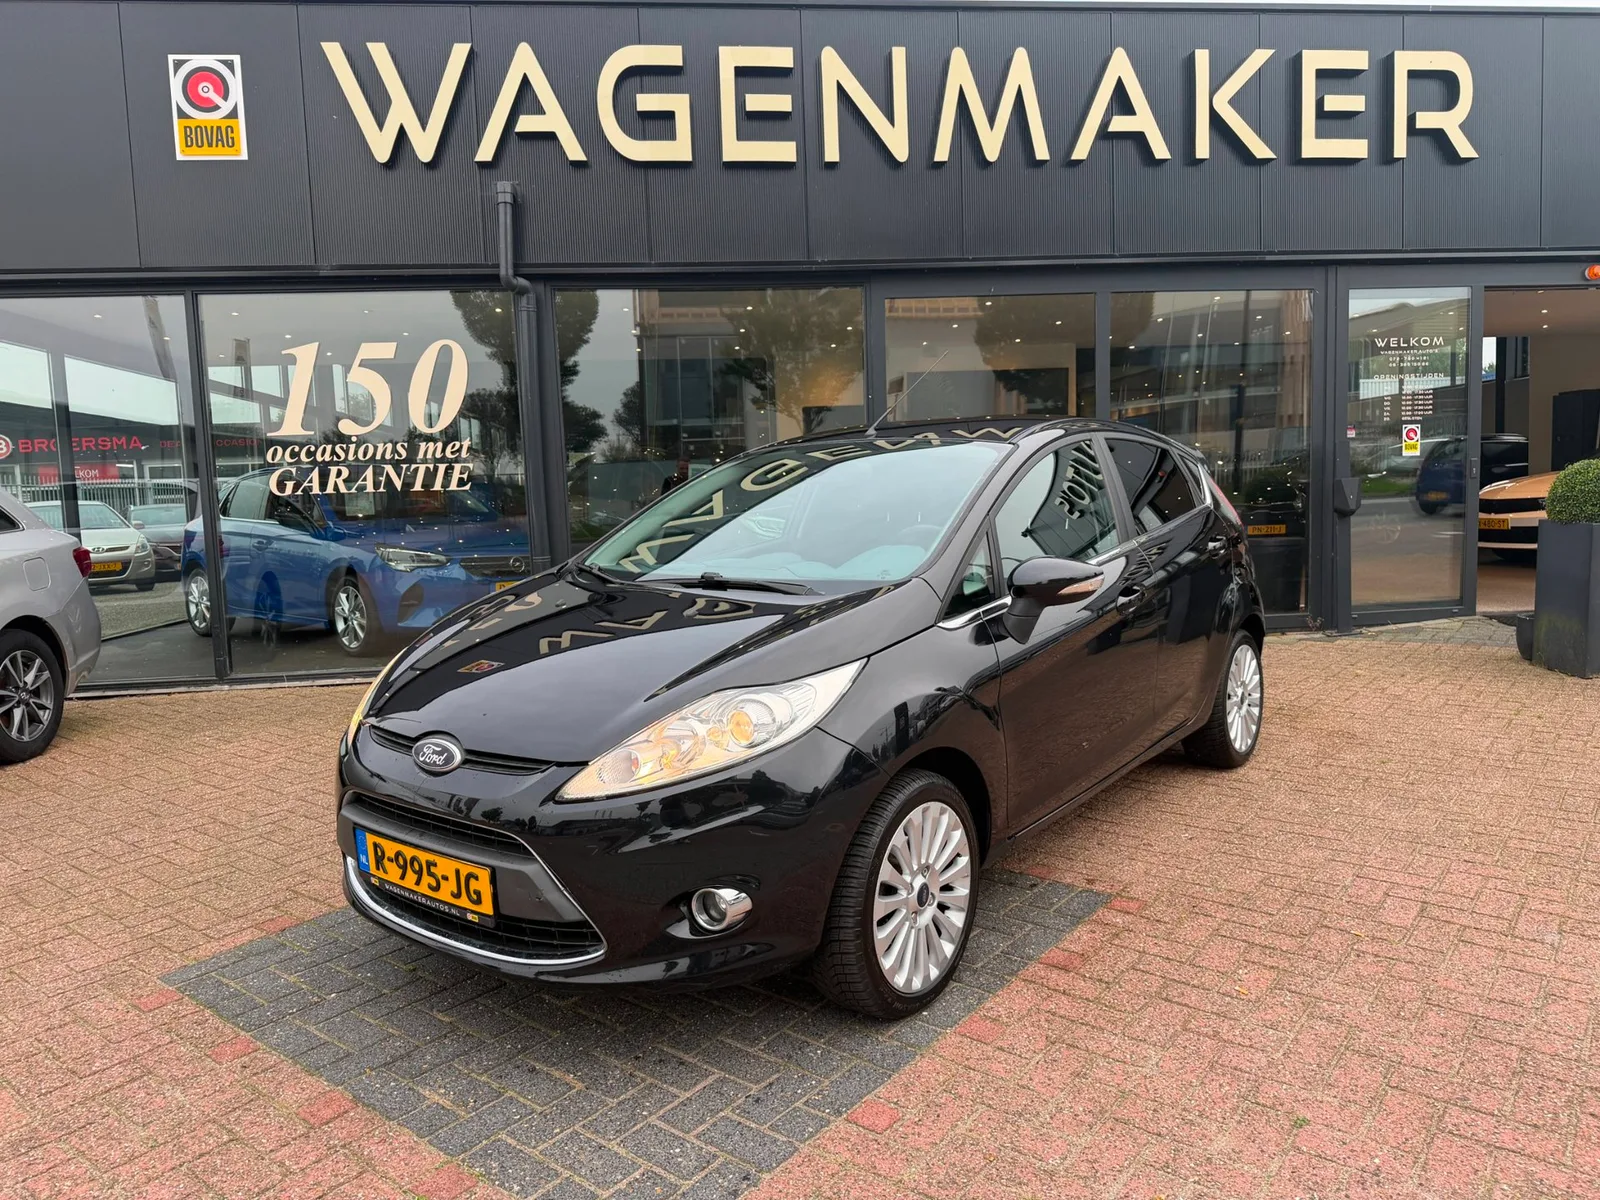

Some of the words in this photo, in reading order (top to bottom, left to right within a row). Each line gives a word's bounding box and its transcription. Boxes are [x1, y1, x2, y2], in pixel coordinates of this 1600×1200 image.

[319, 41, 1480, 164] WAGENMAKER
[183, 125, 236, 149] BOVAG
[1374, 336, 1445, 348] WELKOM
[266, 338, 469, 437] 150
[1373, 372, 1445, 380] OPENINGSTIJDEN
[266, 435, 408, 464] occasions
[418, 436, 472, 460] met
[268, 463, 475, 497] GARANTIE
[418, 743, 448, 766] Ford
[359, 853, 369, 866] NL
[372, 840, 483, 906] R-995-JG
